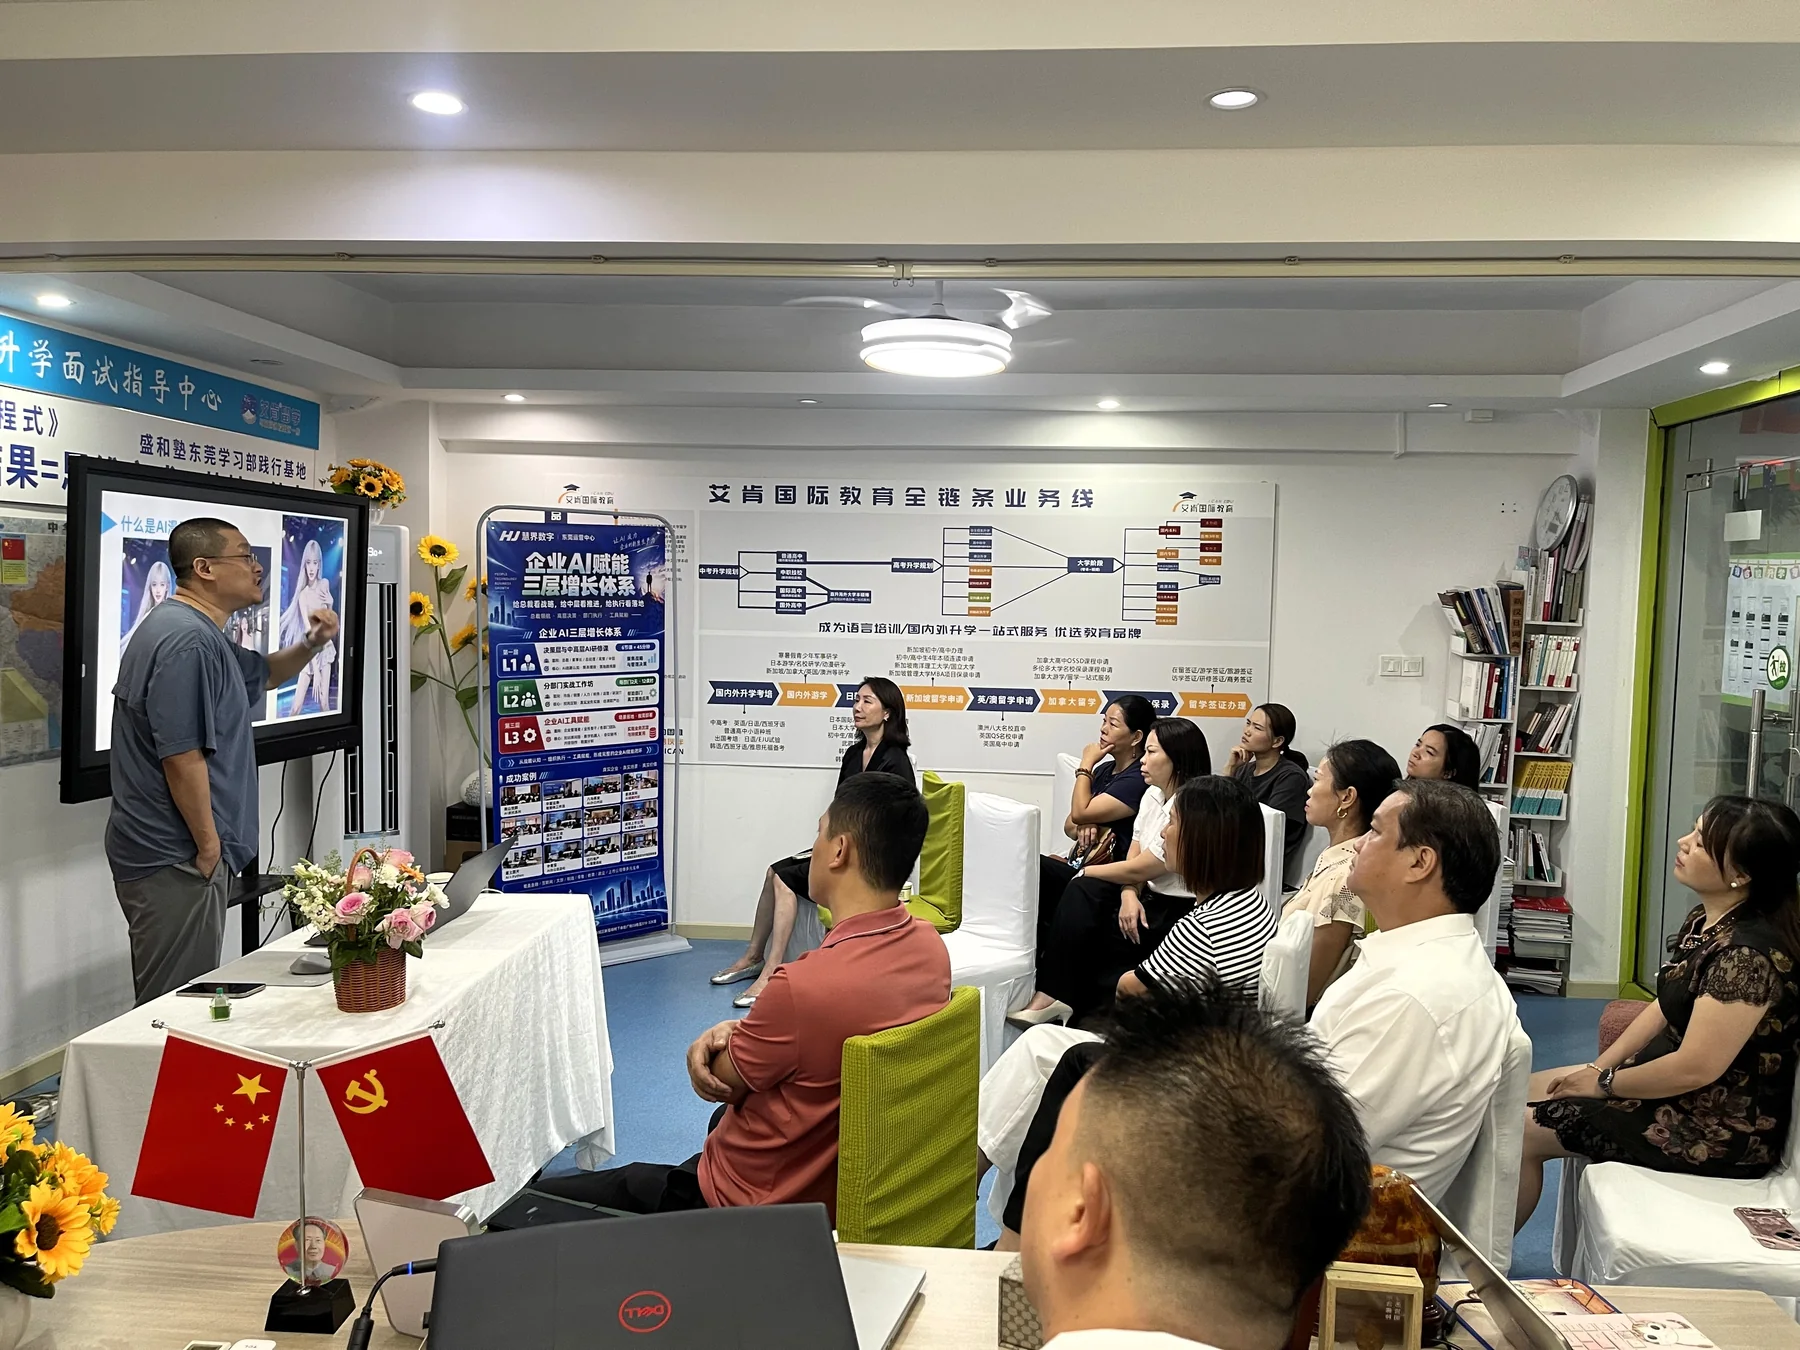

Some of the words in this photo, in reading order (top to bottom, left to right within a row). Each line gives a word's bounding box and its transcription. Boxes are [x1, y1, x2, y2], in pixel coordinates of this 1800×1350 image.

[140, 433, 307, 480] 盛和塾东莞学习部践行基地
[0, 444, 69, 489] 果=
[709, 484, 1094, 508] 艾肯国际教育全链条业务线
[499, 531, 520, 541] HJ
[526, 552, 630, 575] 企业AI赋能
[699, 567, 738, 575] 中考升学规划
[522, 575, 636, 596] 三层增长体系
[819, 622, 1048, 638] 成为语言培训/国内外升学一站式服务
[1054, 626, 1142, 639] 优选教育品牌
[502, 658, 516, 672] L1
[894, 662, 975, 670] 新加坡南洋理工大学/国立大学
[1032, 665, 1113, 673] 多伦多大学名校保录课程申请
[889, 670, 981, 678] 新加坡管理大学MBA项目保录申请
[716, 688, 773, 699] 国内外升学考培
[787, 690, 828, 699] 国内外游学
[906, 694, 964, 704] 新加坡留学申请
[503, 695, 519, 708] L2
[978, 695, 1034, 705] 英/澳留学申请
[1048, 697, 1096, 707] 加拿大留学
[1148, 700, 1170, 709] 保录
[1189, 700, 1246, 710] 留学签证办理
[504, 731, 520, 745] L3
[506, 772, 536, 784] 成功案例
[624, 1304, 664, 1319] DELL
